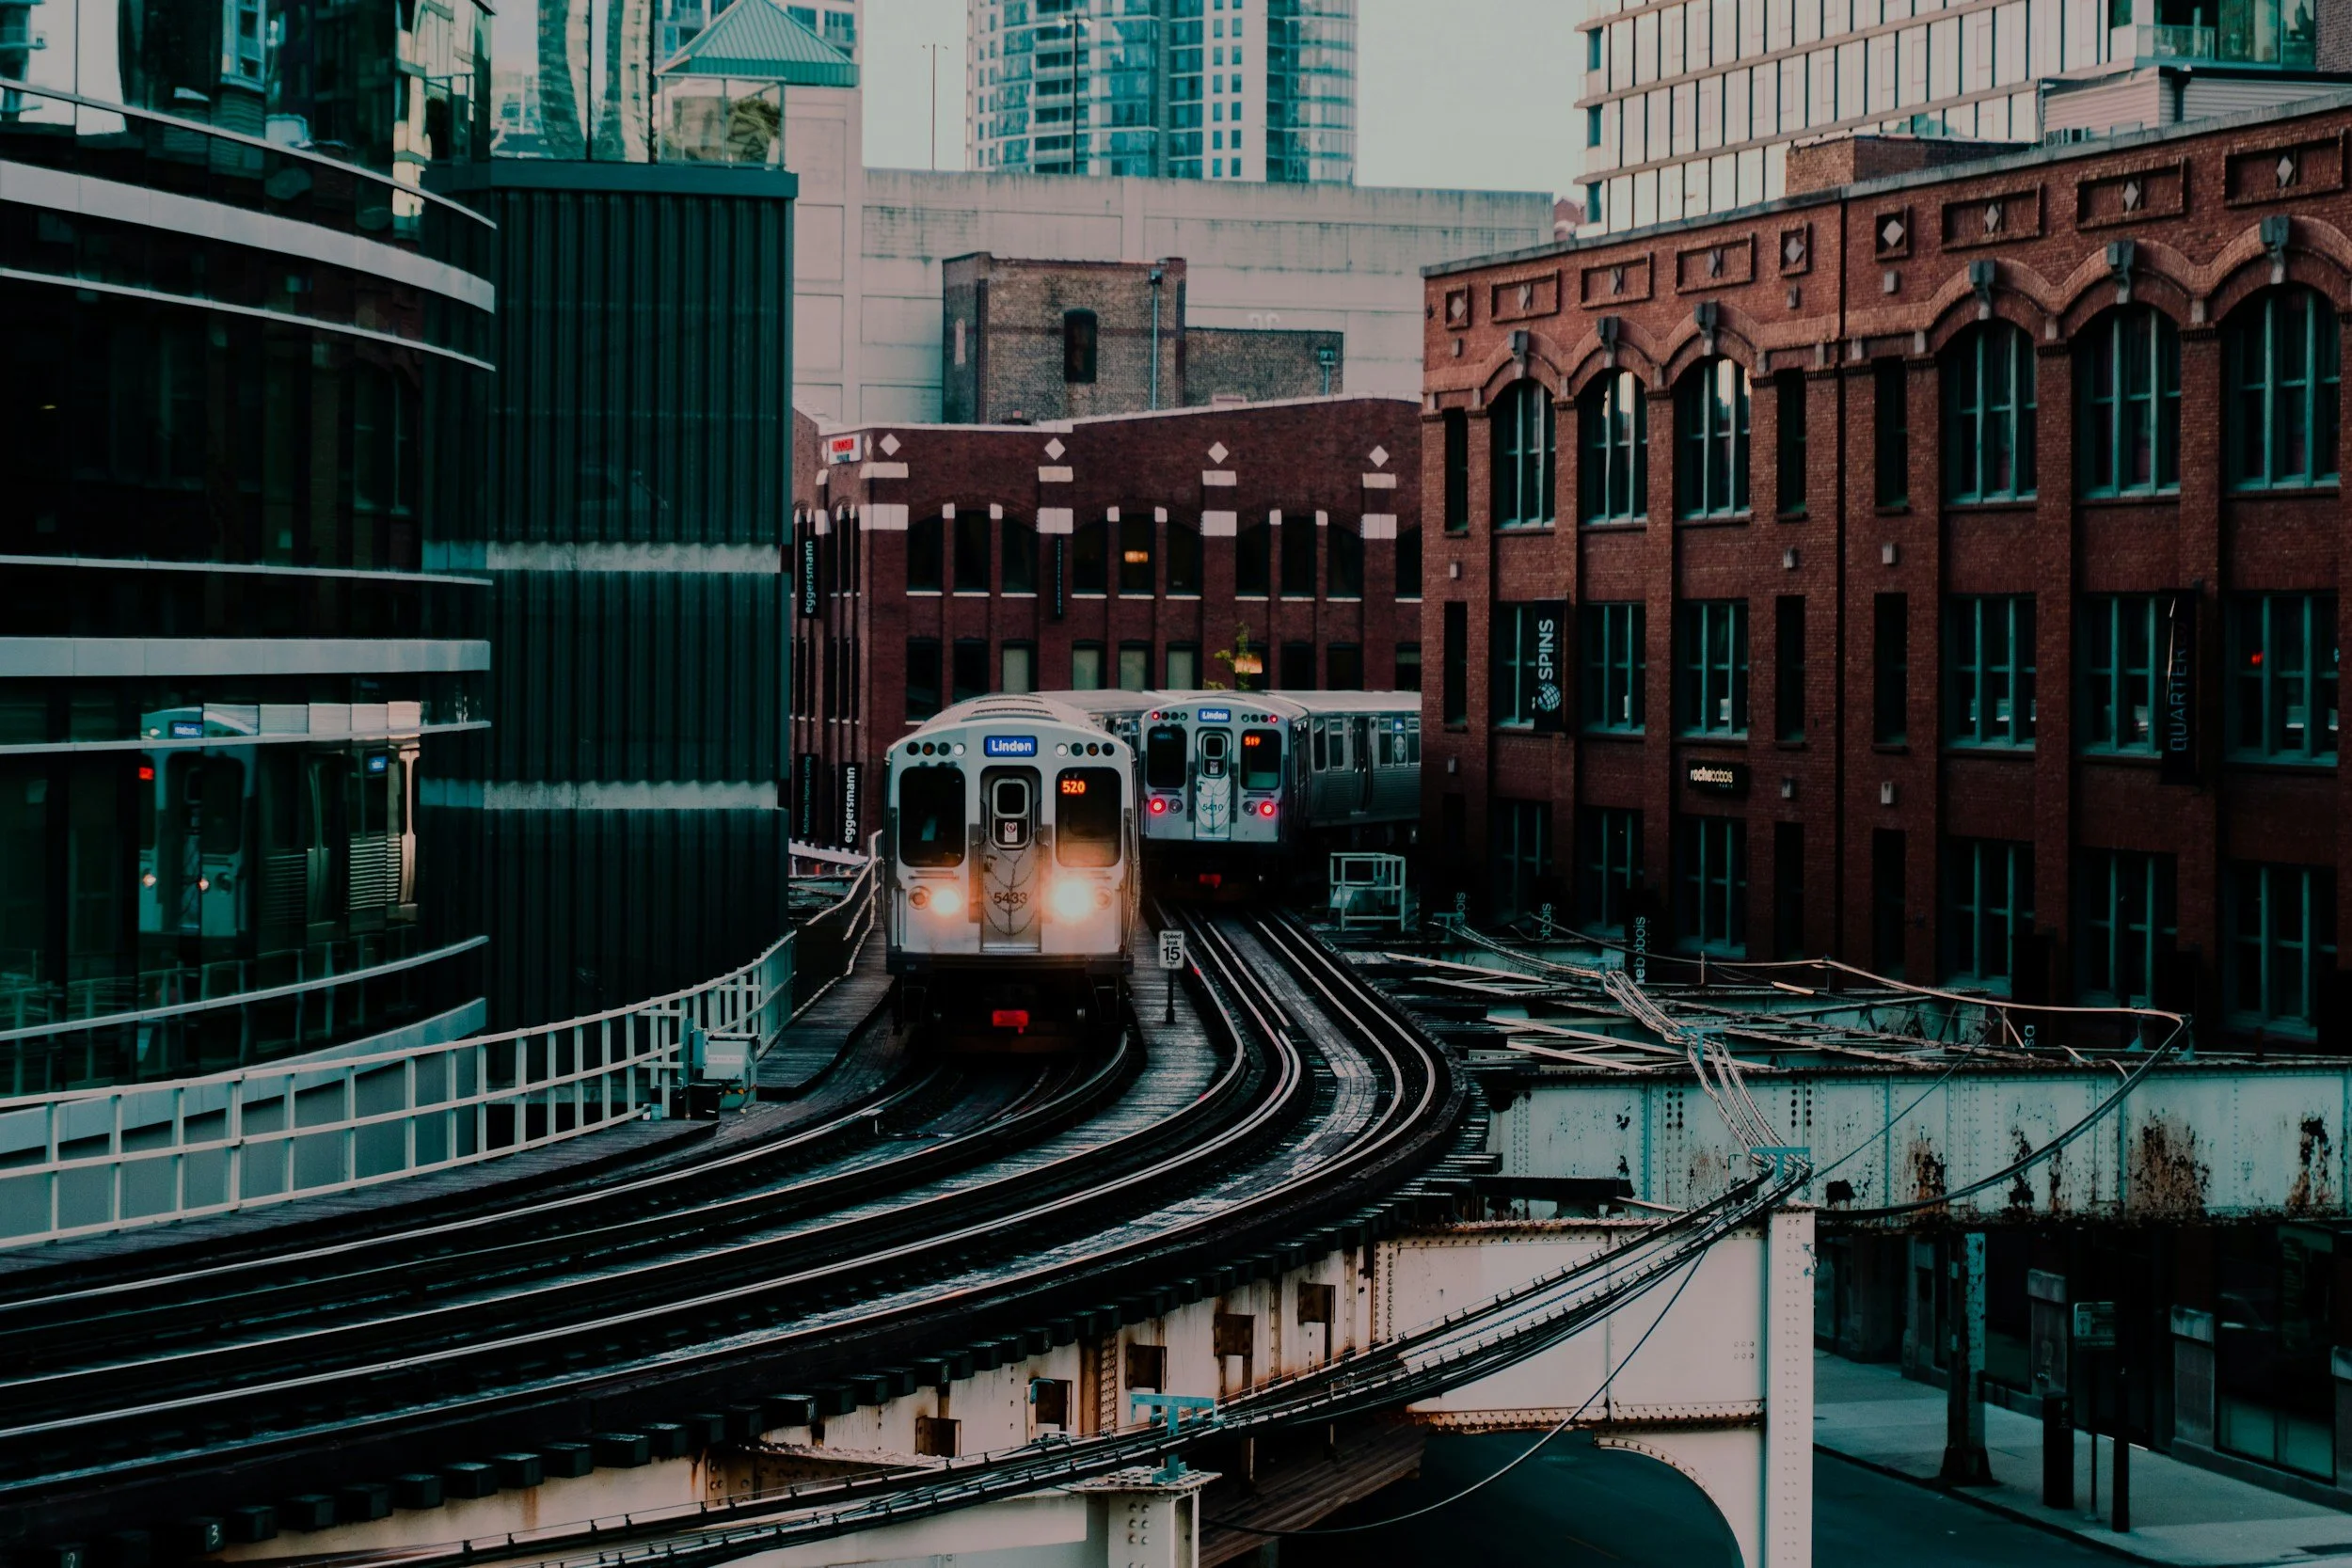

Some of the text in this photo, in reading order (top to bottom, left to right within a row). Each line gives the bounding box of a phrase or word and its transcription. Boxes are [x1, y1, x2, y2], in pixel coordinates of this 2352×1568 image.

[804, 540, 817, 614] eggersmann
[1537, 618, 1554, 681] SPINS
[1201, 710, 1229, 721] Linden
[991, 738, 1033, 752] Linden
[1244, 735, 1262, 747] 519
[1061, 780, 1088, 795] 520
[844, 767, 857, 844] eggersmann
[993, 892, 1027, 904] 5433
[1163, 932, 1182, 941] Speed
[1163, 946, 1181, 961] 15
